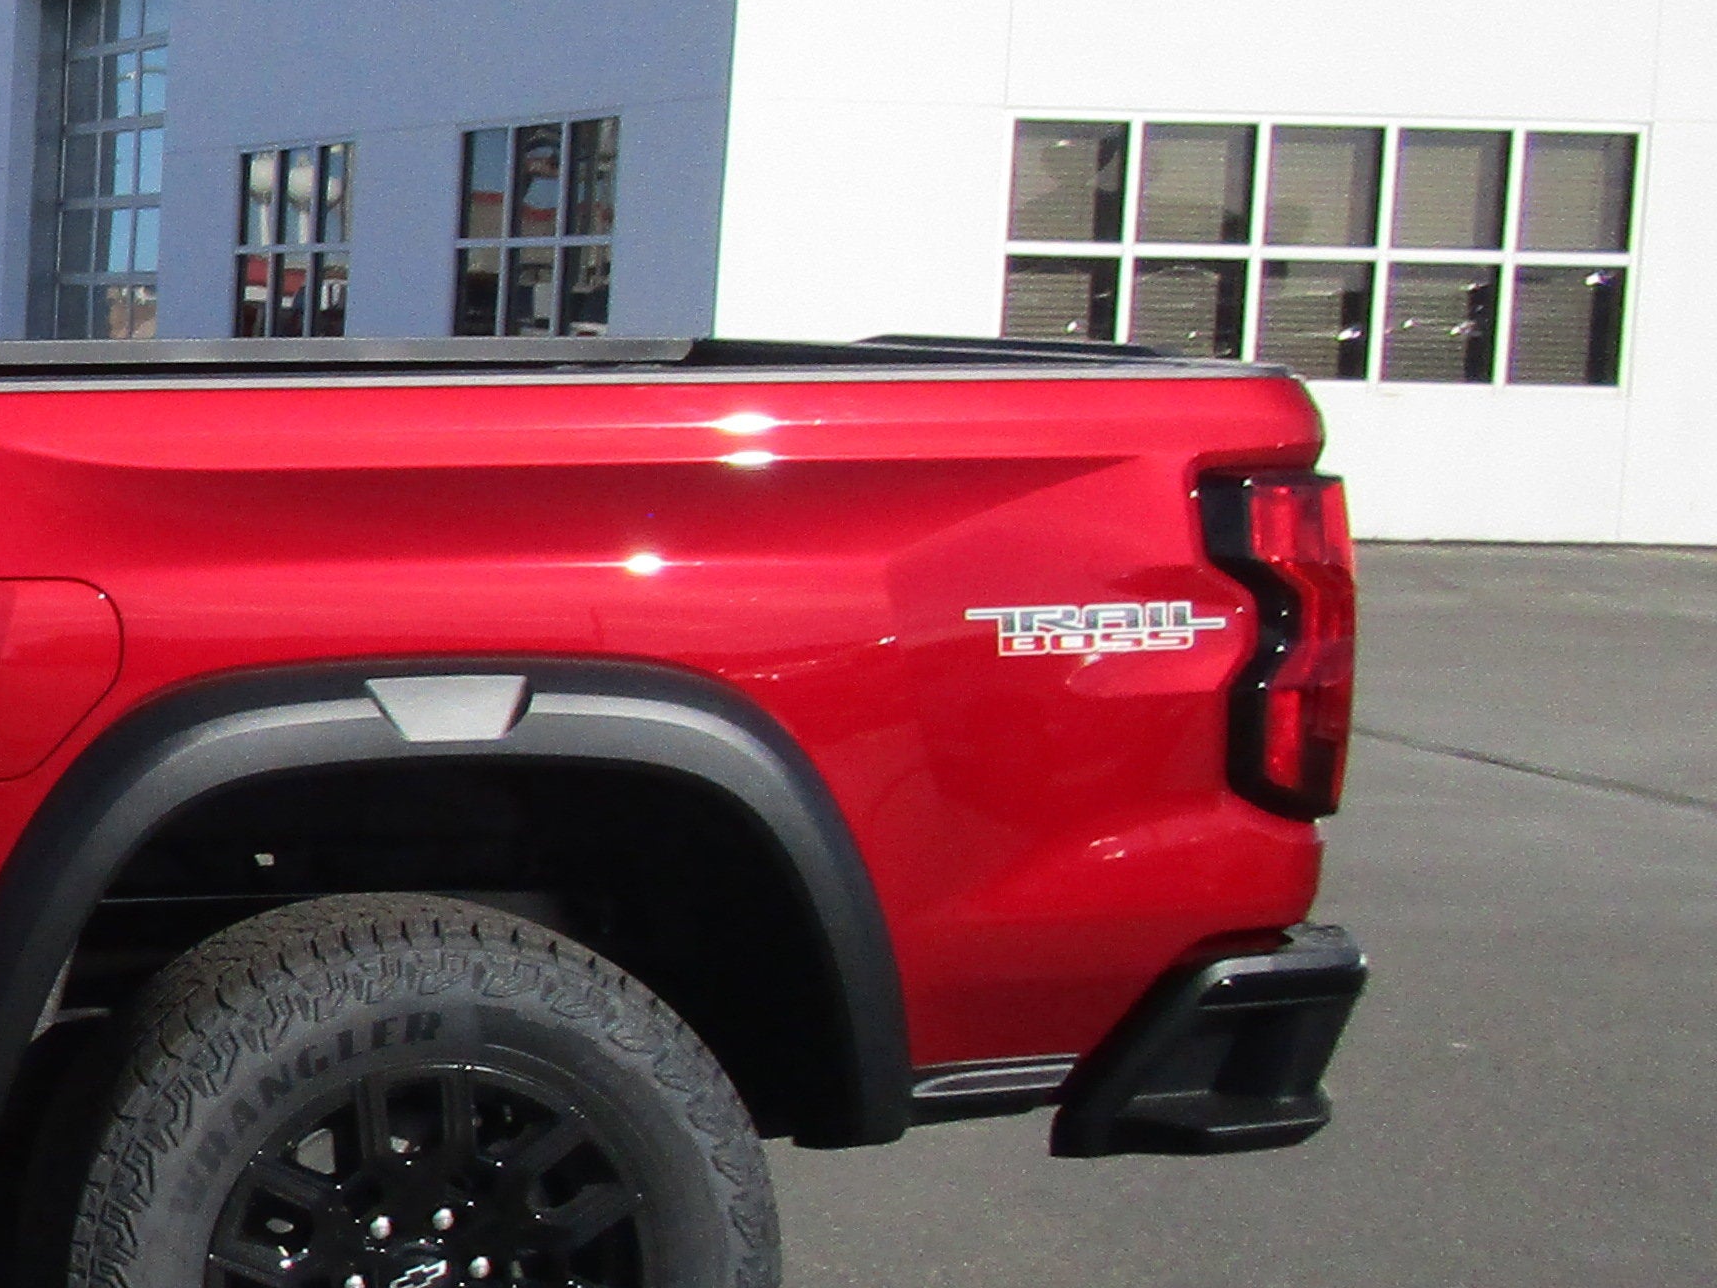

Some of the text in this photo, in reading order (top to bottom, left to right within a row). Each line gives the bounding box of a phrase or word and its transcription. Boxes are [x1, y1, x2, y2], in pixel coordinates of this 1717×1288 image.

[965, 601, 1227, 634] TRAIL
[998, 629, 1195, 657] BOSS
[169, 1011, 443, 1214] WRANGLER
